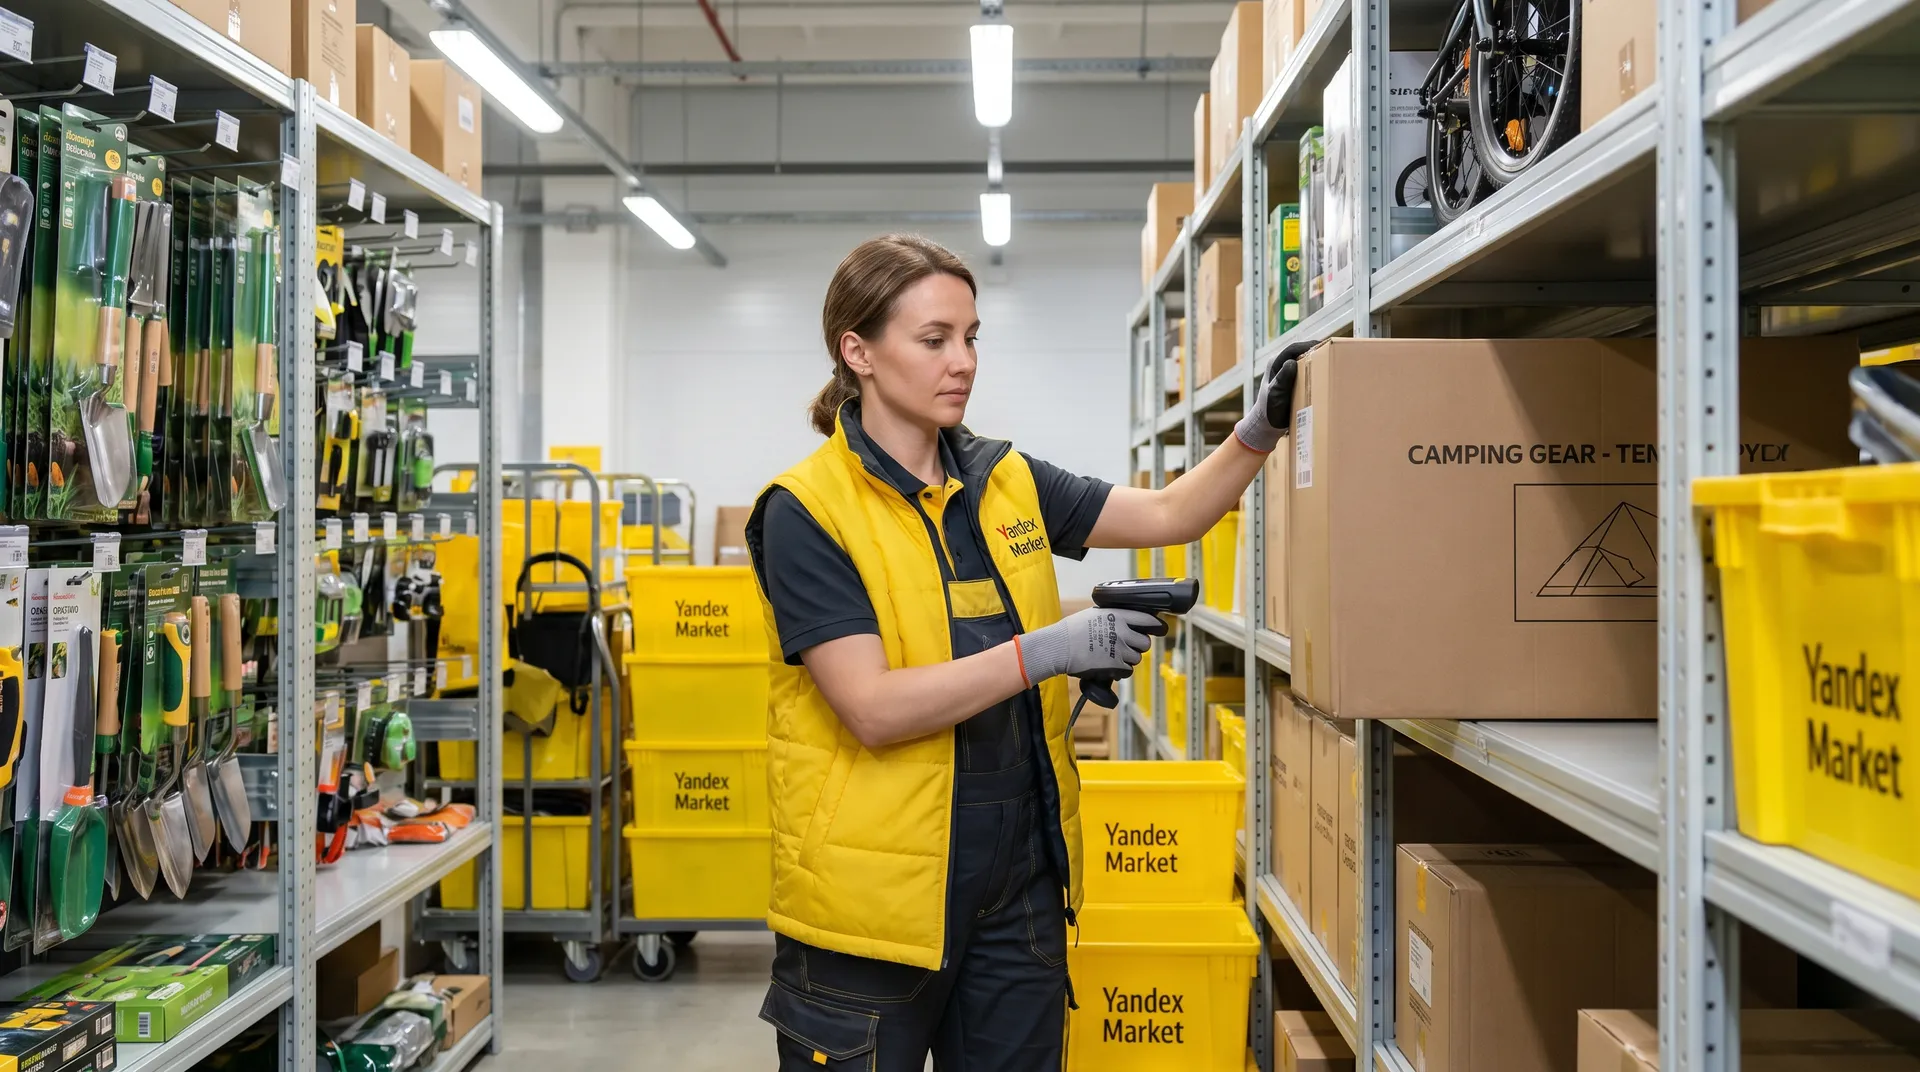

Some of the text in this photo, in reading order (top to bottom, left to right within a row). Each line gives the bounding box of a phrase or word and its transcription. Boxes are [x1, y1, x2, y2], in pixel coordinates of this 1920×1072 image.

[1408, 444, 1523, 465] CAMPING
[1529, 444, 1596, 465] GEAR
[996, 518, 1039, 540] Yandex
[1009, 536, 1047, 558] Market
[675, 600, 729, 617] Yandex
[675, 621, 730, 638] Market
[1802, 642, 1902, 722] Yandex
[1807, 717, 1903, 801] Market
[675, 772, 729, 790] Yandex
[675, 793, 730, 811] Market
[1105, 822, 1178, 846] Yandex
[1105, 851, 1178, 873] Market
[1103, 986, 1184, 1014] Yandex
[1103, 1018, 1184, 1044] Market
